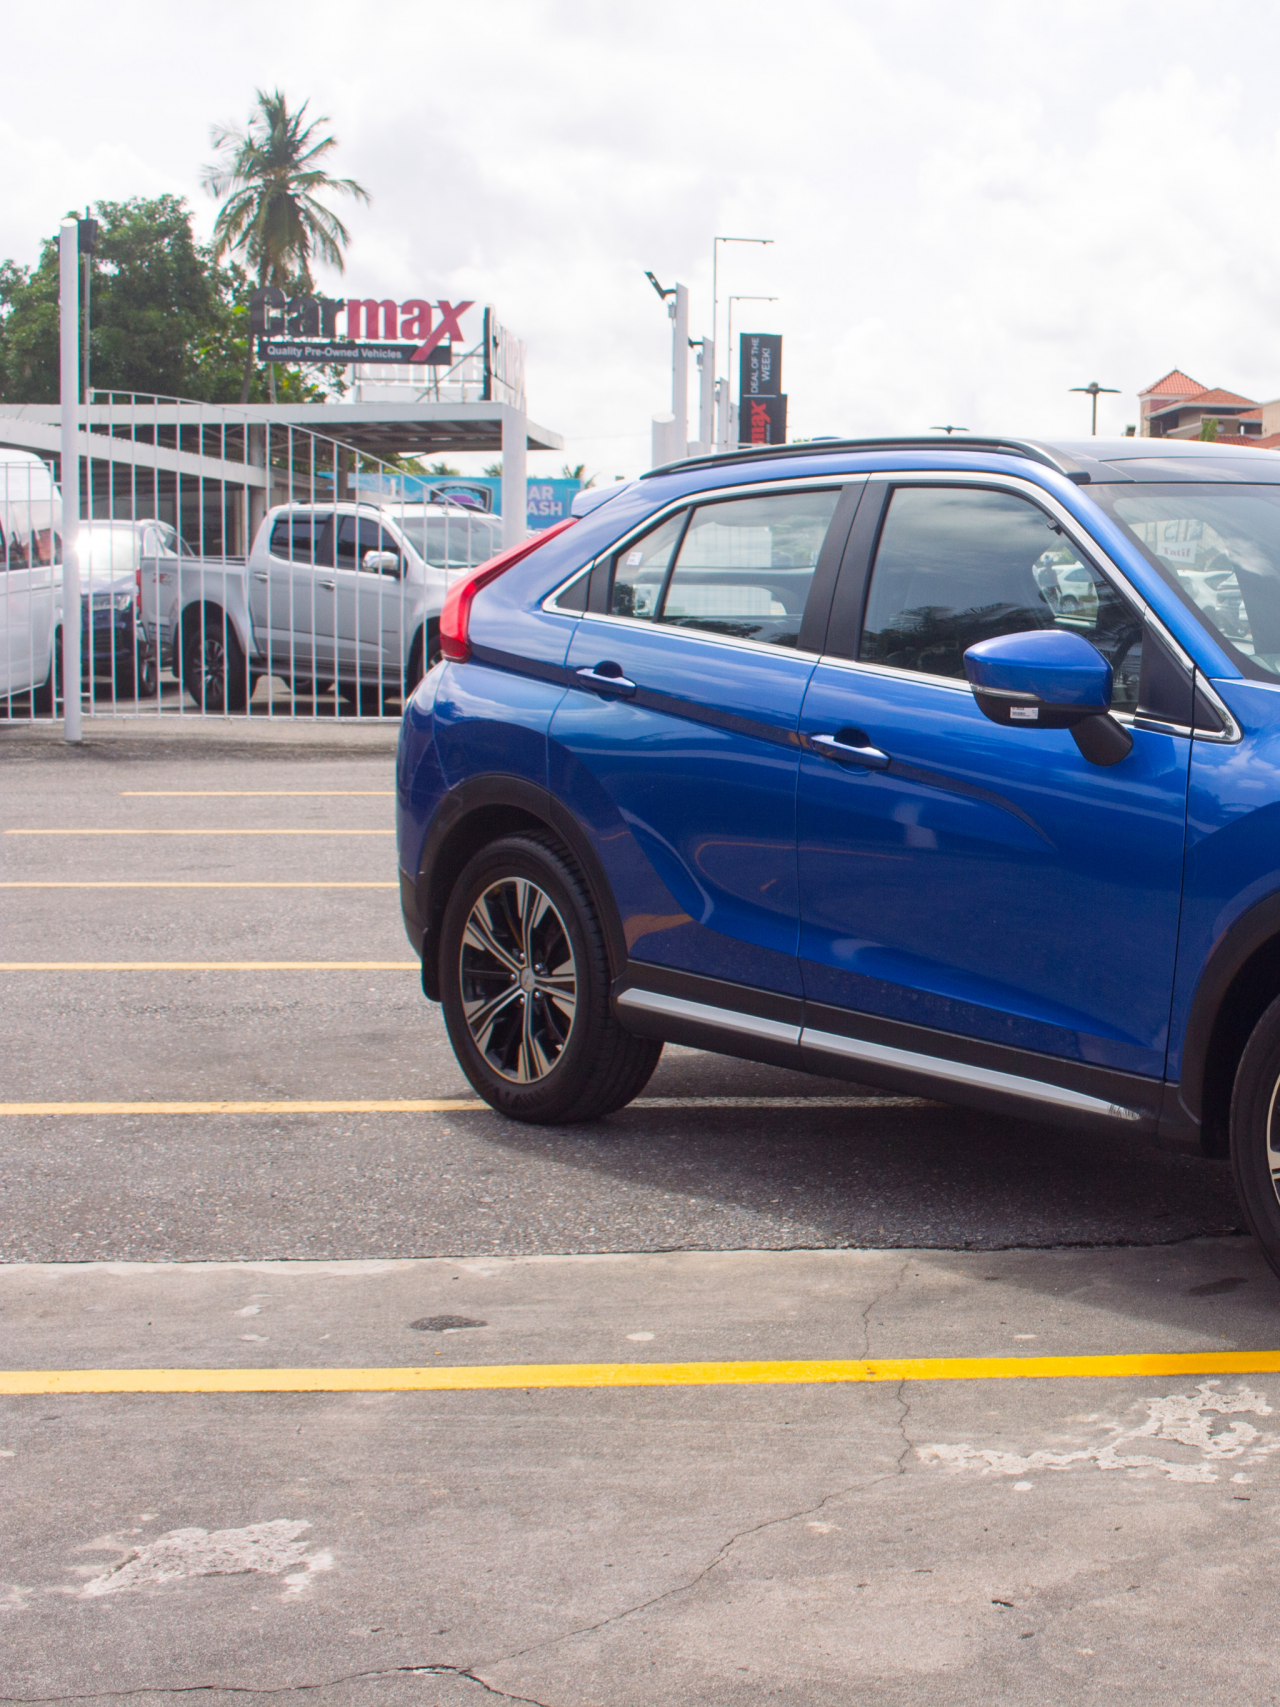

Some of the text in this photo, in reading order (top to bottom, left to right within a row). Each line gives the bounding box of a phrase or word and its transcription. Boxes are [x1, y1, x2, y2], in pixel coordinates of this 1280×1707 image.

[250, 287, 476, 361] Carmax
[267, 345, 402, 359] Quality Pre-Owned Vehicles
[750, 337, 760, 393] DEAL OF THE
[761, 348, 771, 382] WEEK!
[751, 400, 771, 444] max
[527, 501, 563, 516] ASH
[528, 485, 554, 501] AR
